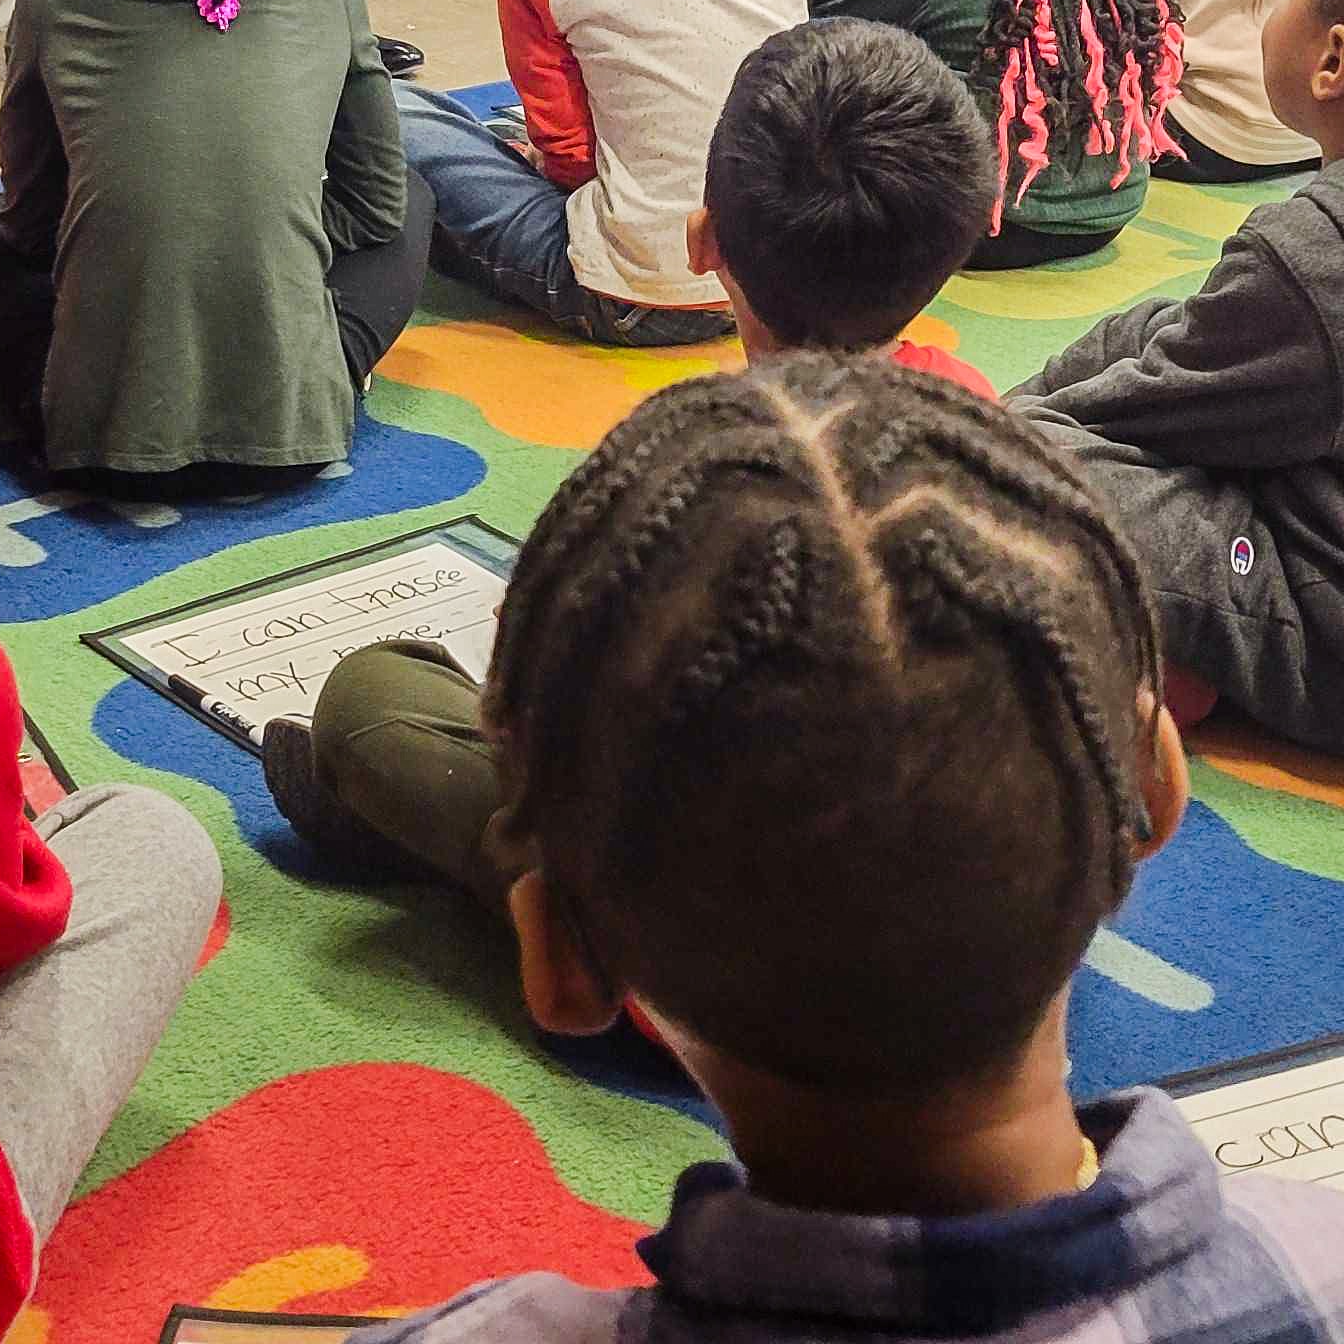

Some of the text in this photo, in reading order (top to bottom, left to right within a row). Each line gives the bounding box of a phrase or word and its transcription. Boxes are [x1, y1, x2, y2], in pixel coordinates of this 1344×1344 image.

[163, 632, 221, 669] I
[242, 612, 330, 649] can
[227, 622, 451, 703] my nme.
